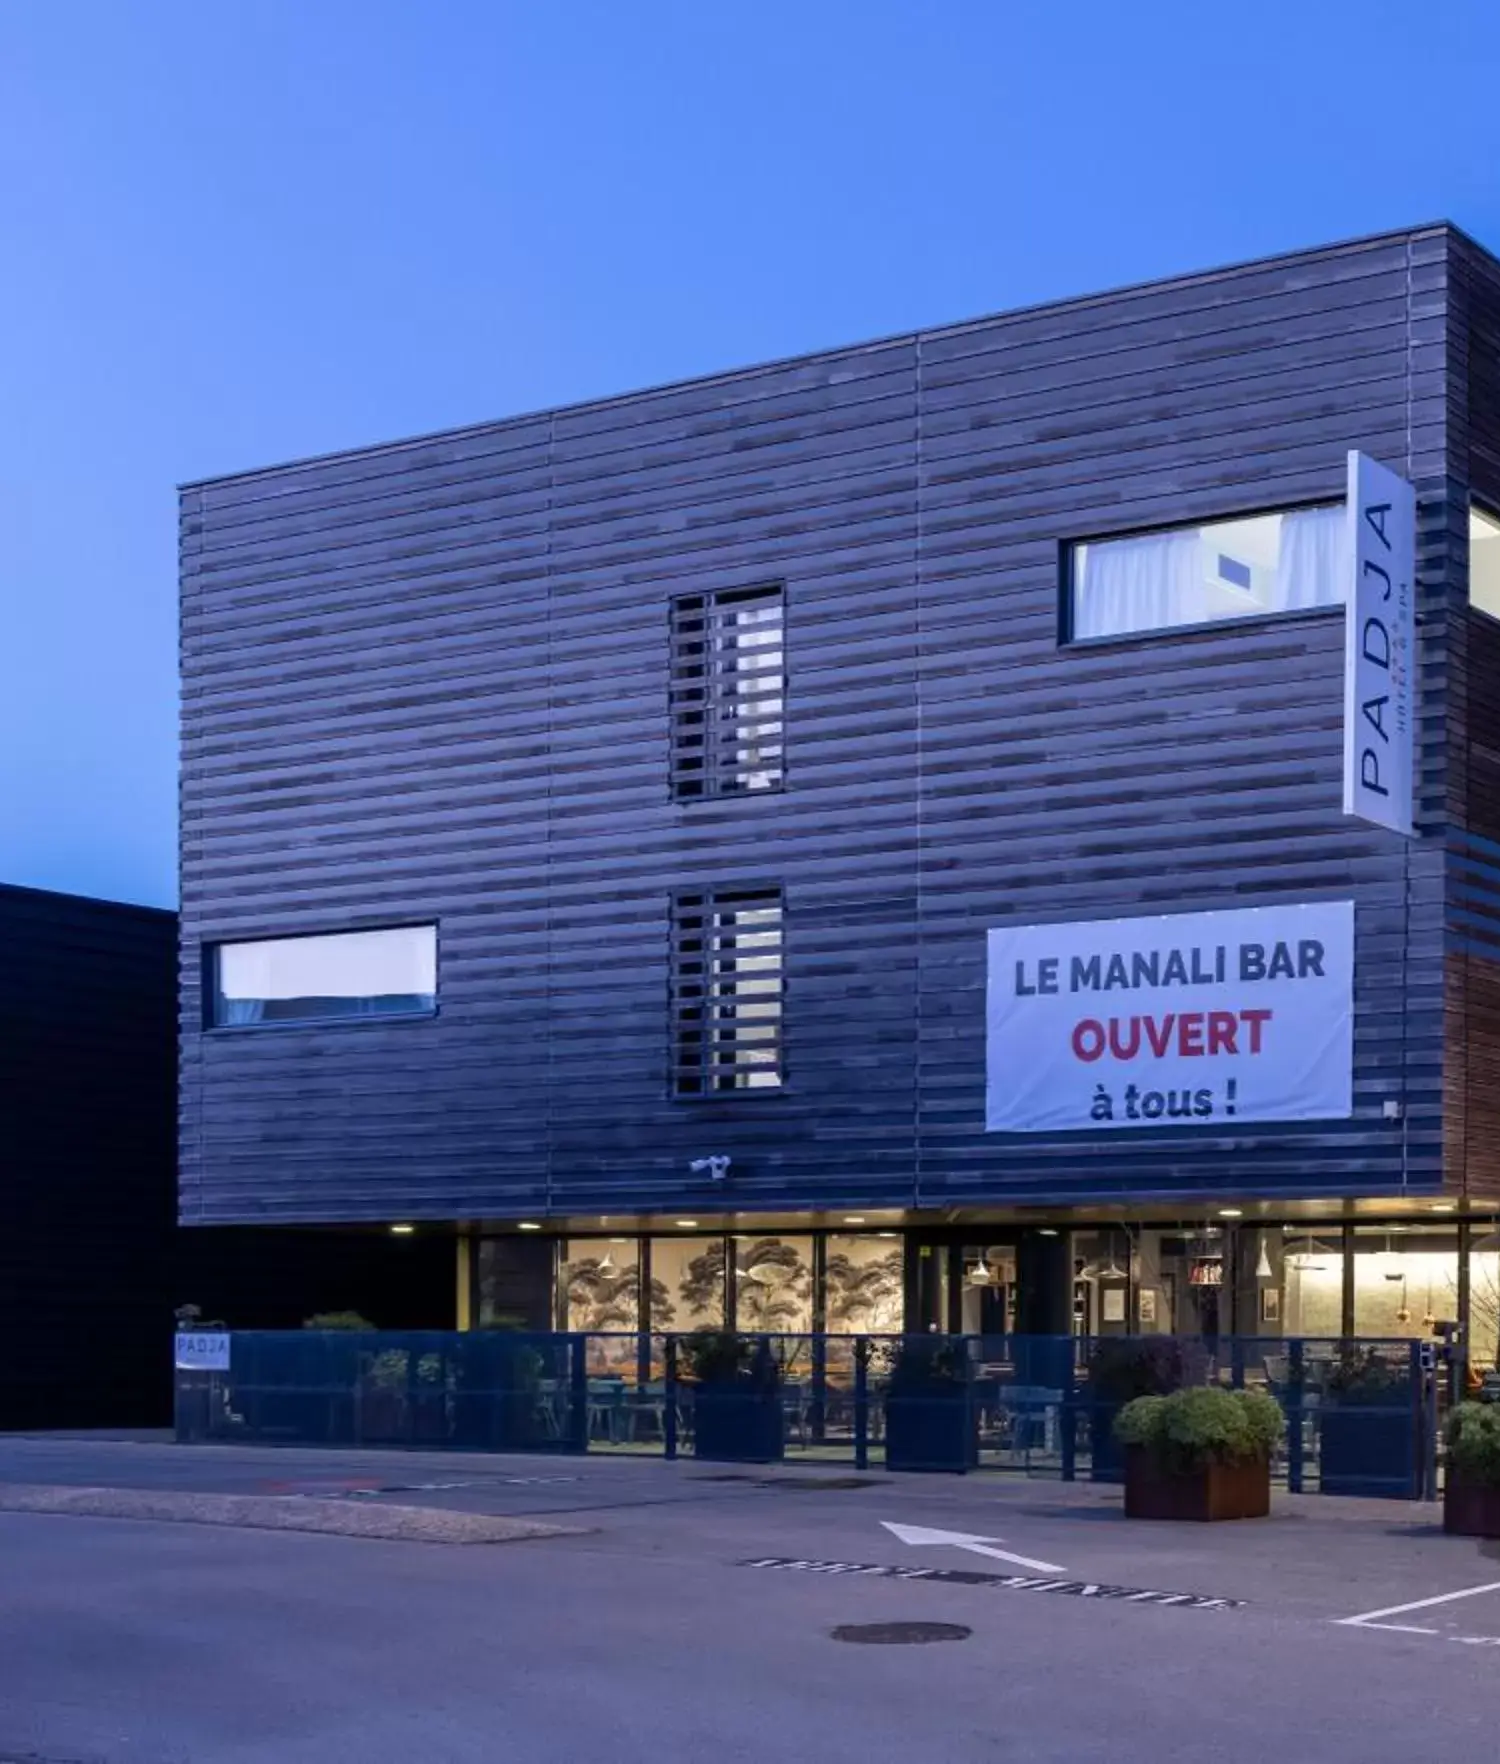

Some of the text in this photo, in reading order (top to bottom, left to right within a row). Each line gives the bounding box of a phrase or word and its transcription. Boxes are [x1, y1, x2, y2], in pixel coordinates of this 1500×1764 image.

[1361, 503, 1393, 797] PADJA
[1015, 939, 1325, 996] LE MANALI BAR
[1071, 1008, 1273, 1063] OUVERT
[1091, 1078, 1237, 1121] à tous !
